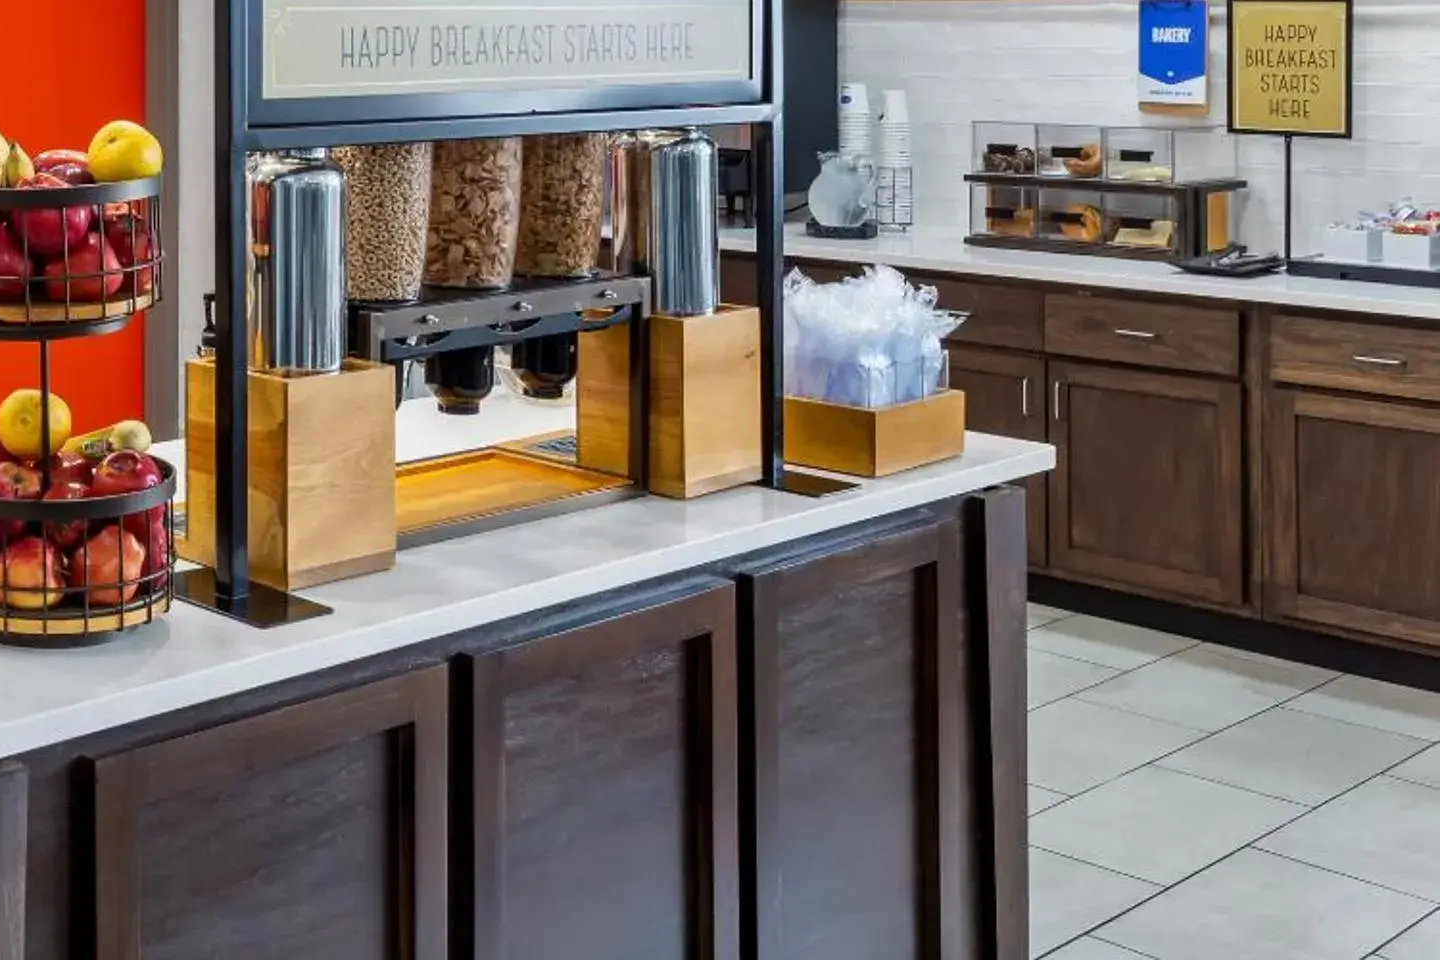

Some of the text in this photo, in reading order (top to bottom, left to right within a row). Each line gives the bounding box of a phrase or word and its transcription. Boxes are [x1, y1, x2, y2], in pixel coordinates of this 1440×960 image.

[1151, 27, 1192, 43] BAKERY
[1264, 24, 1318, 42] HAPPY
[340, 22, 695, 68] HAPPY BREAKFAST STARTS HERE
[1244, 49, 1336, 70] BREAKFAST
[1260, 74, 1320, 95] STARTS
[1268, 98, 1311, 119] HERE
